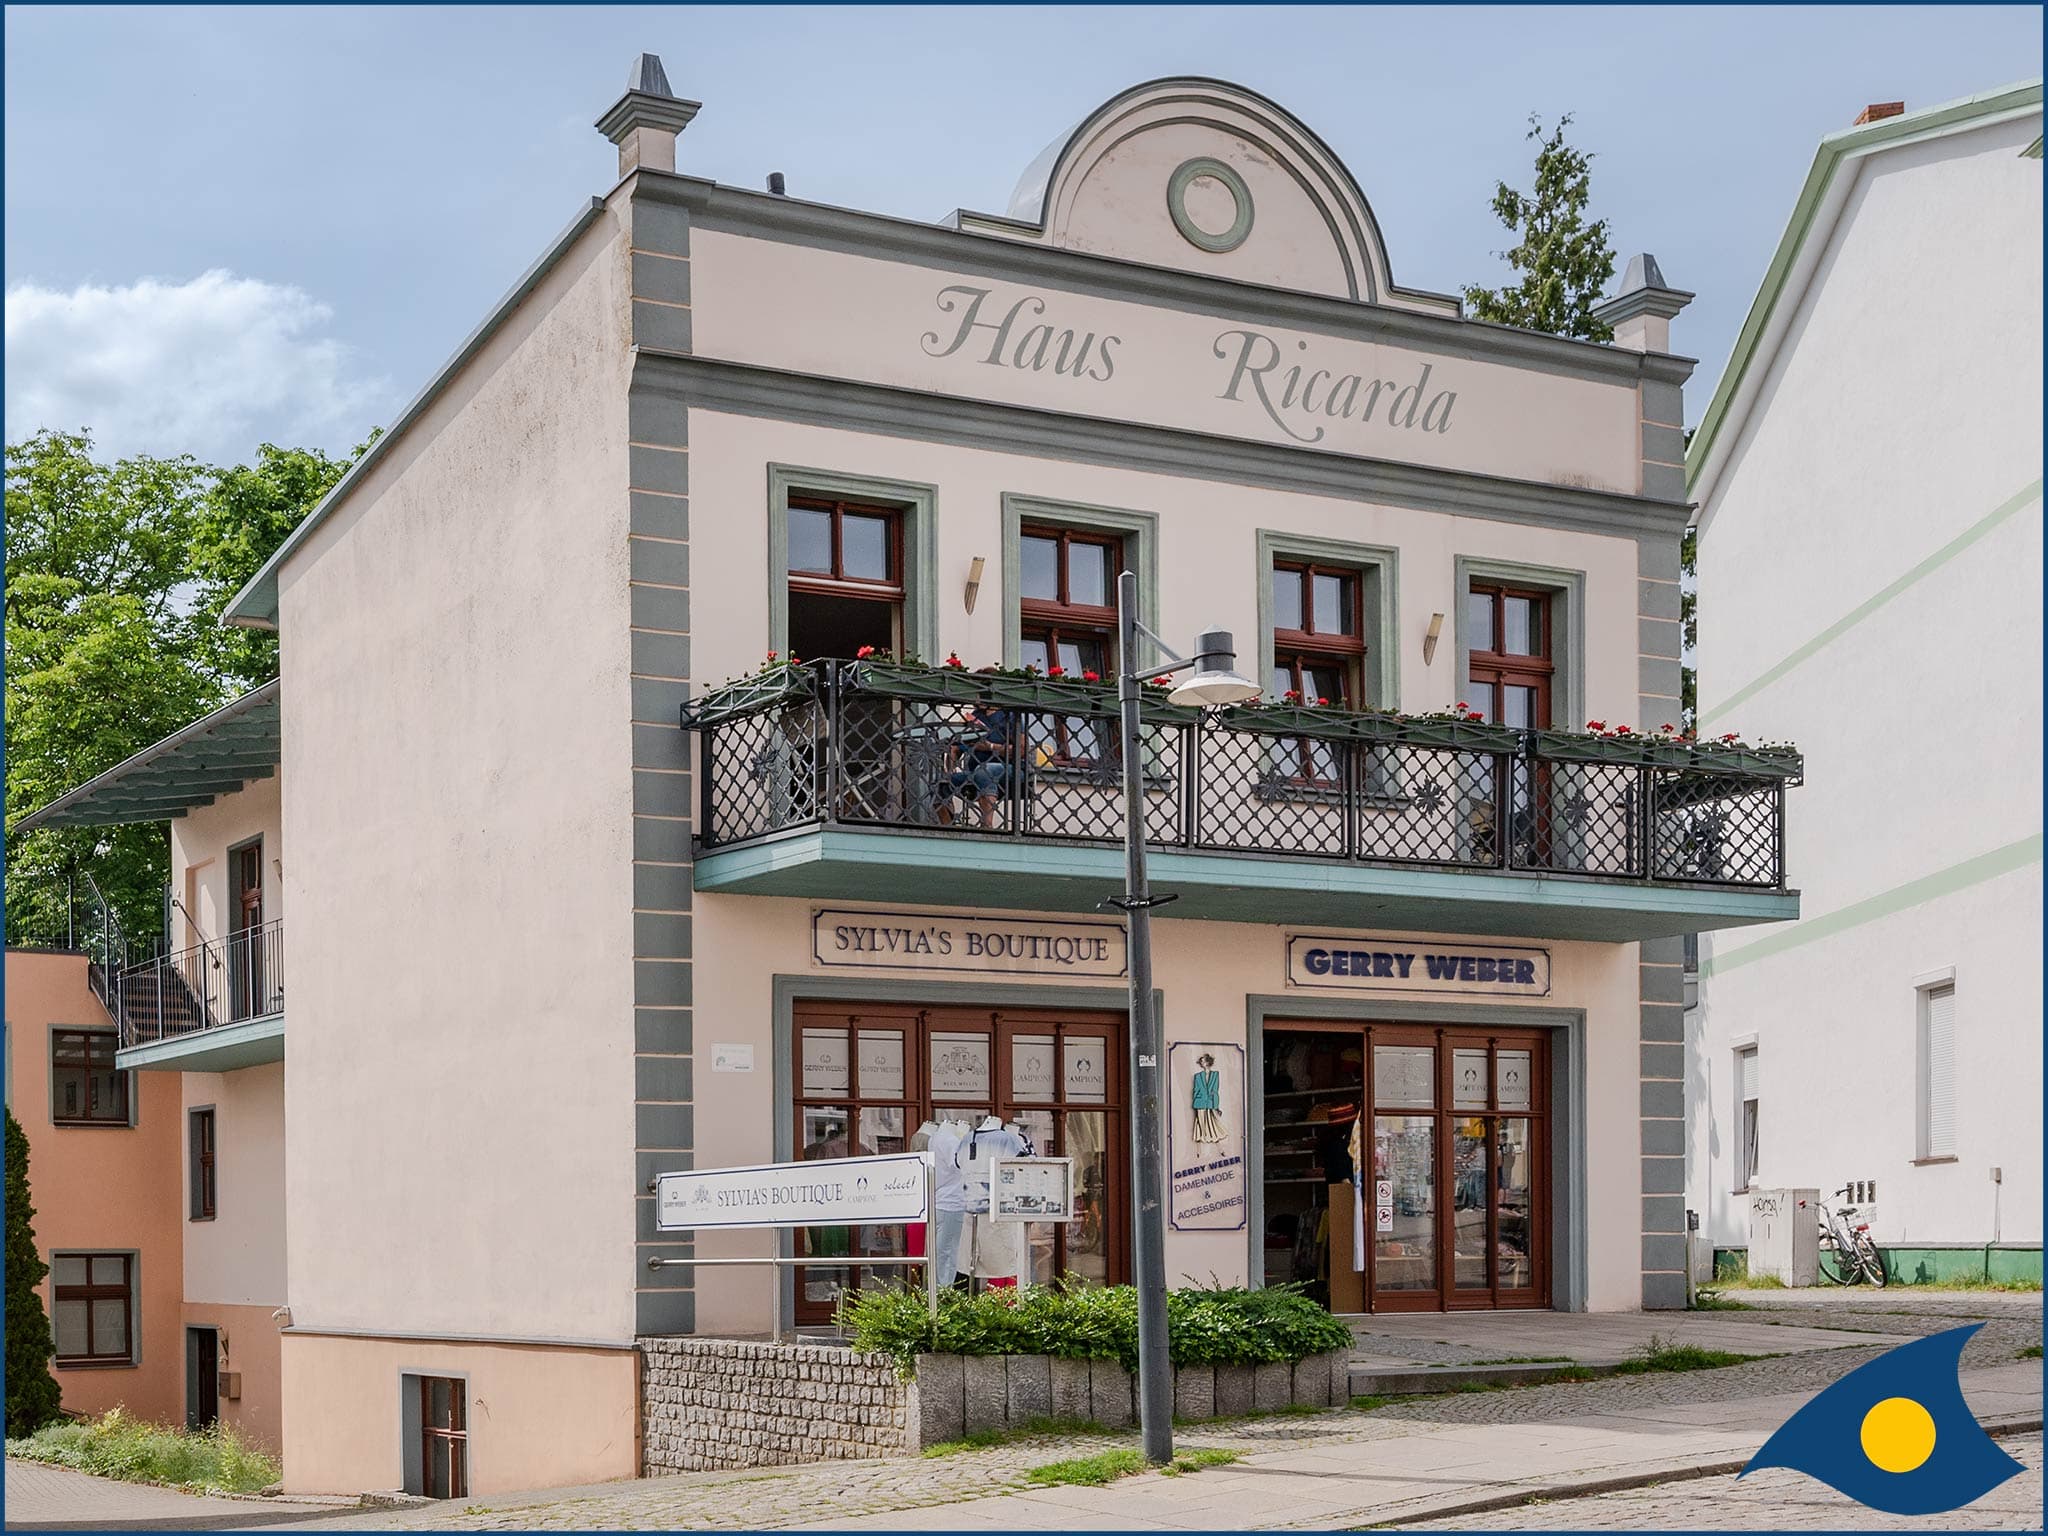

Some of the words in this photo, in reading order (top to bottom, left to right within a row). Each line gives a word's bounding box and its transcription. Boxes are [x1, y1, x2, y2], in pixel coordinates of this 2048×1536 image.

[919, 284, 1122, 383] Haus
[1211, 329, 1460, 444] Ricarda
[834, 925, 953, 956] SYLVIA'S
[965, 931, 1110, 965] BOUTIQUE
[1303, 948, 1416, 980] GERRY
[1425, 954, 1536, 985] WEBER
[1174, 1164, 1206, 1179] GERRY
[1208, 1155, 1242, 1171] WEBER
[1174, 1169, 1235, 1193] DAMENMODE
[717, 1187, 768, 1207] SYLVIA'S
[771, 1183, 843, 1205] BOUTIQUE
[1204, 1190, 1212, 1200] &
[1177, 1195, 1244, 1220] ACCESSOIRES
